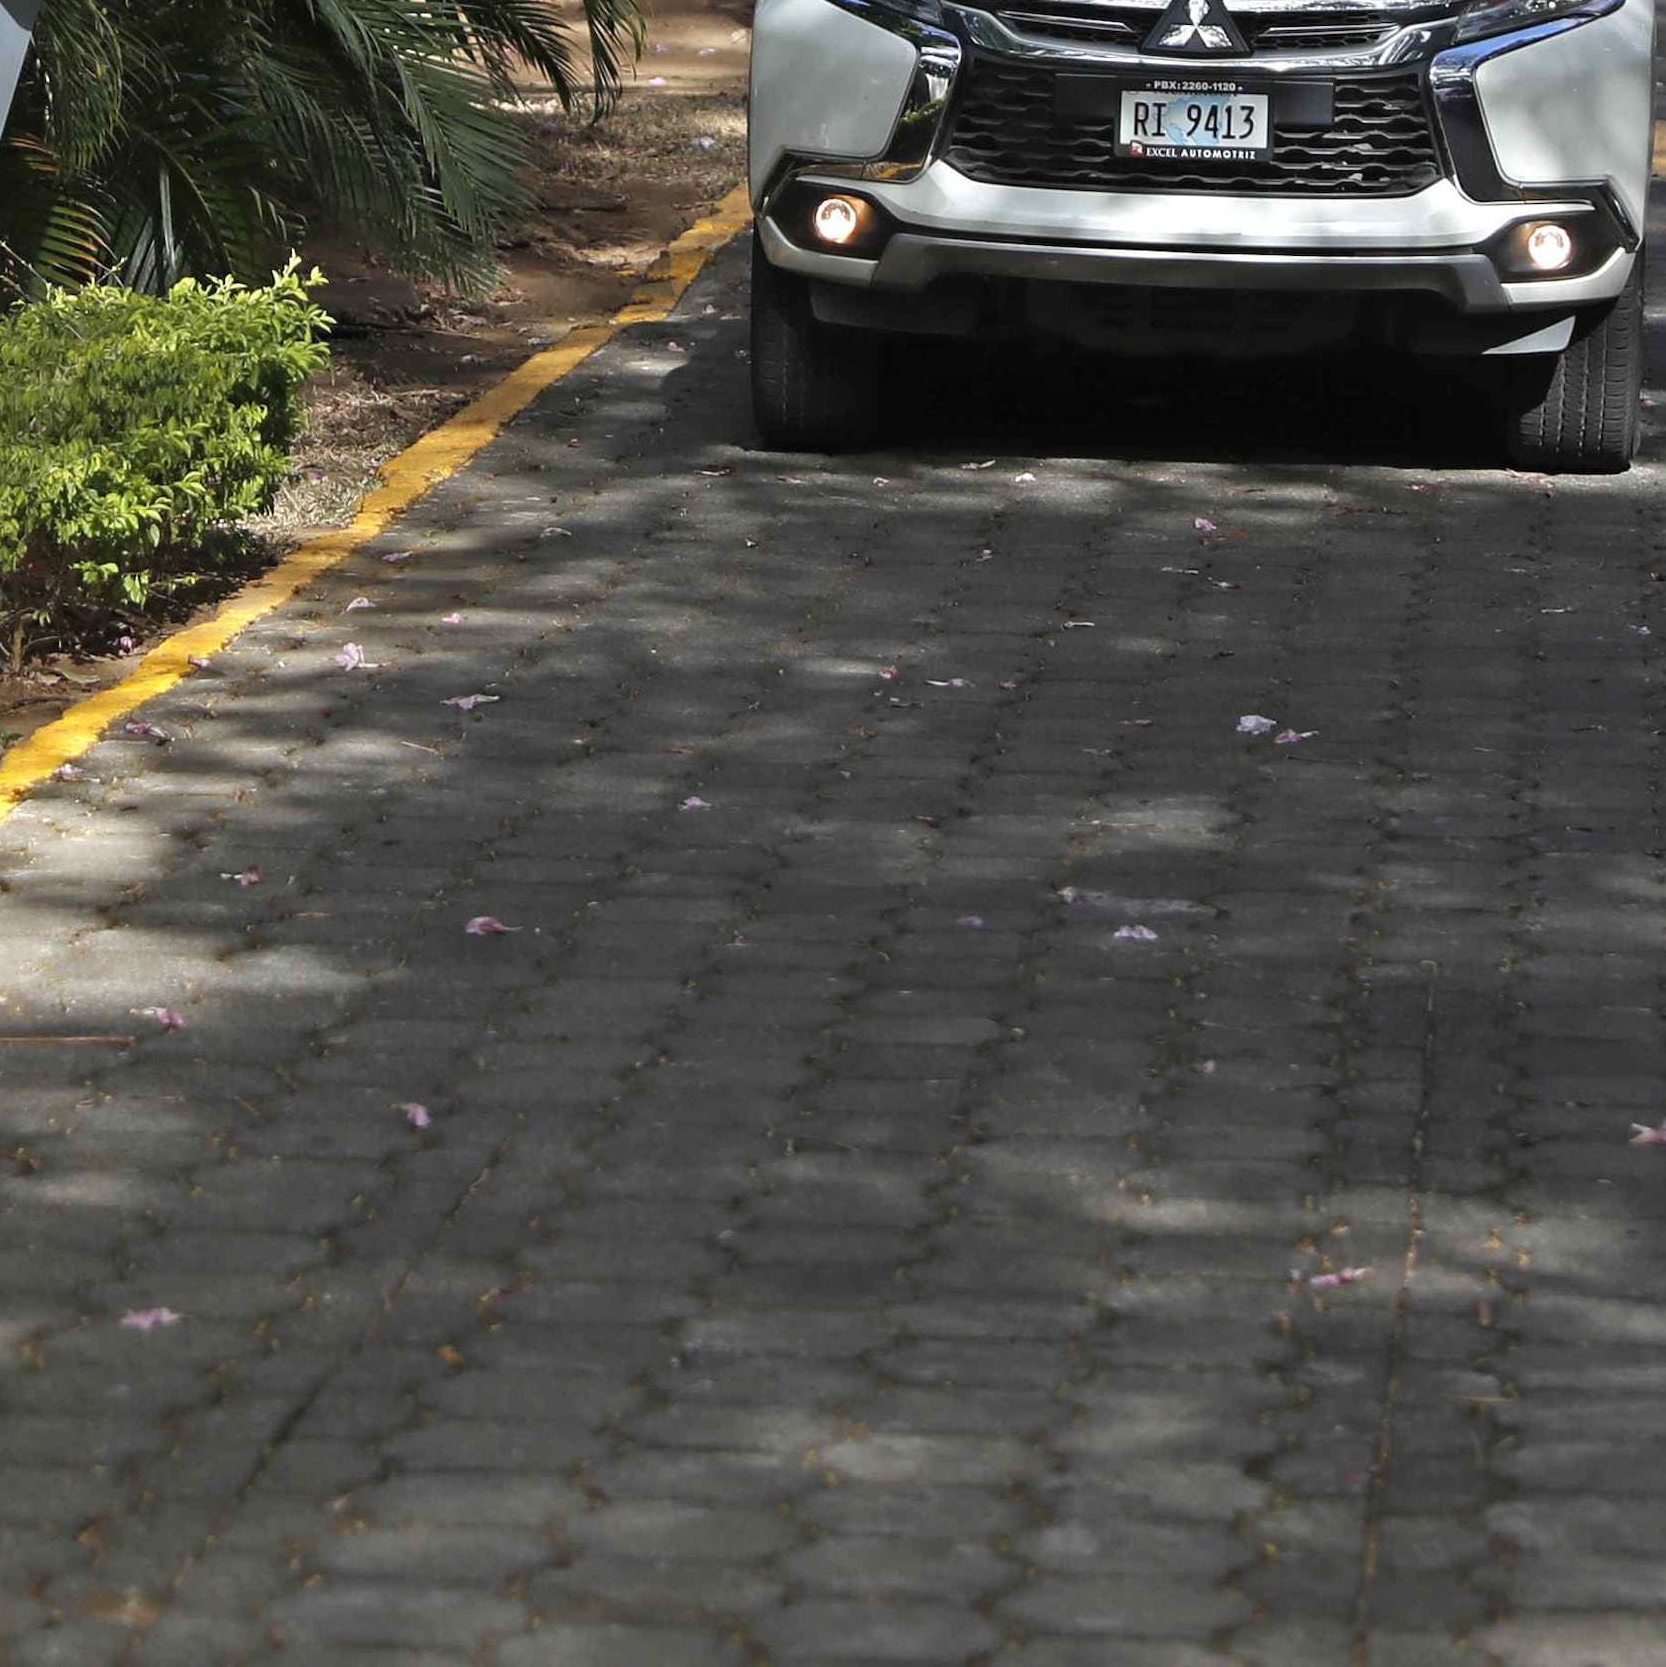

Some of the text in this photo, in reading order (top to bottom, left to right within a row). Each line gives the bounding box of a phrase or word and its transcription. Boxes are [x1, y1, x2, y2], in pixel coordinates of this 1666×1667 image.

[1133, 102, 1255, 140] RI 9413
[1145, 147, 1257, 161] EXCEL AUTOMOTRIZ
